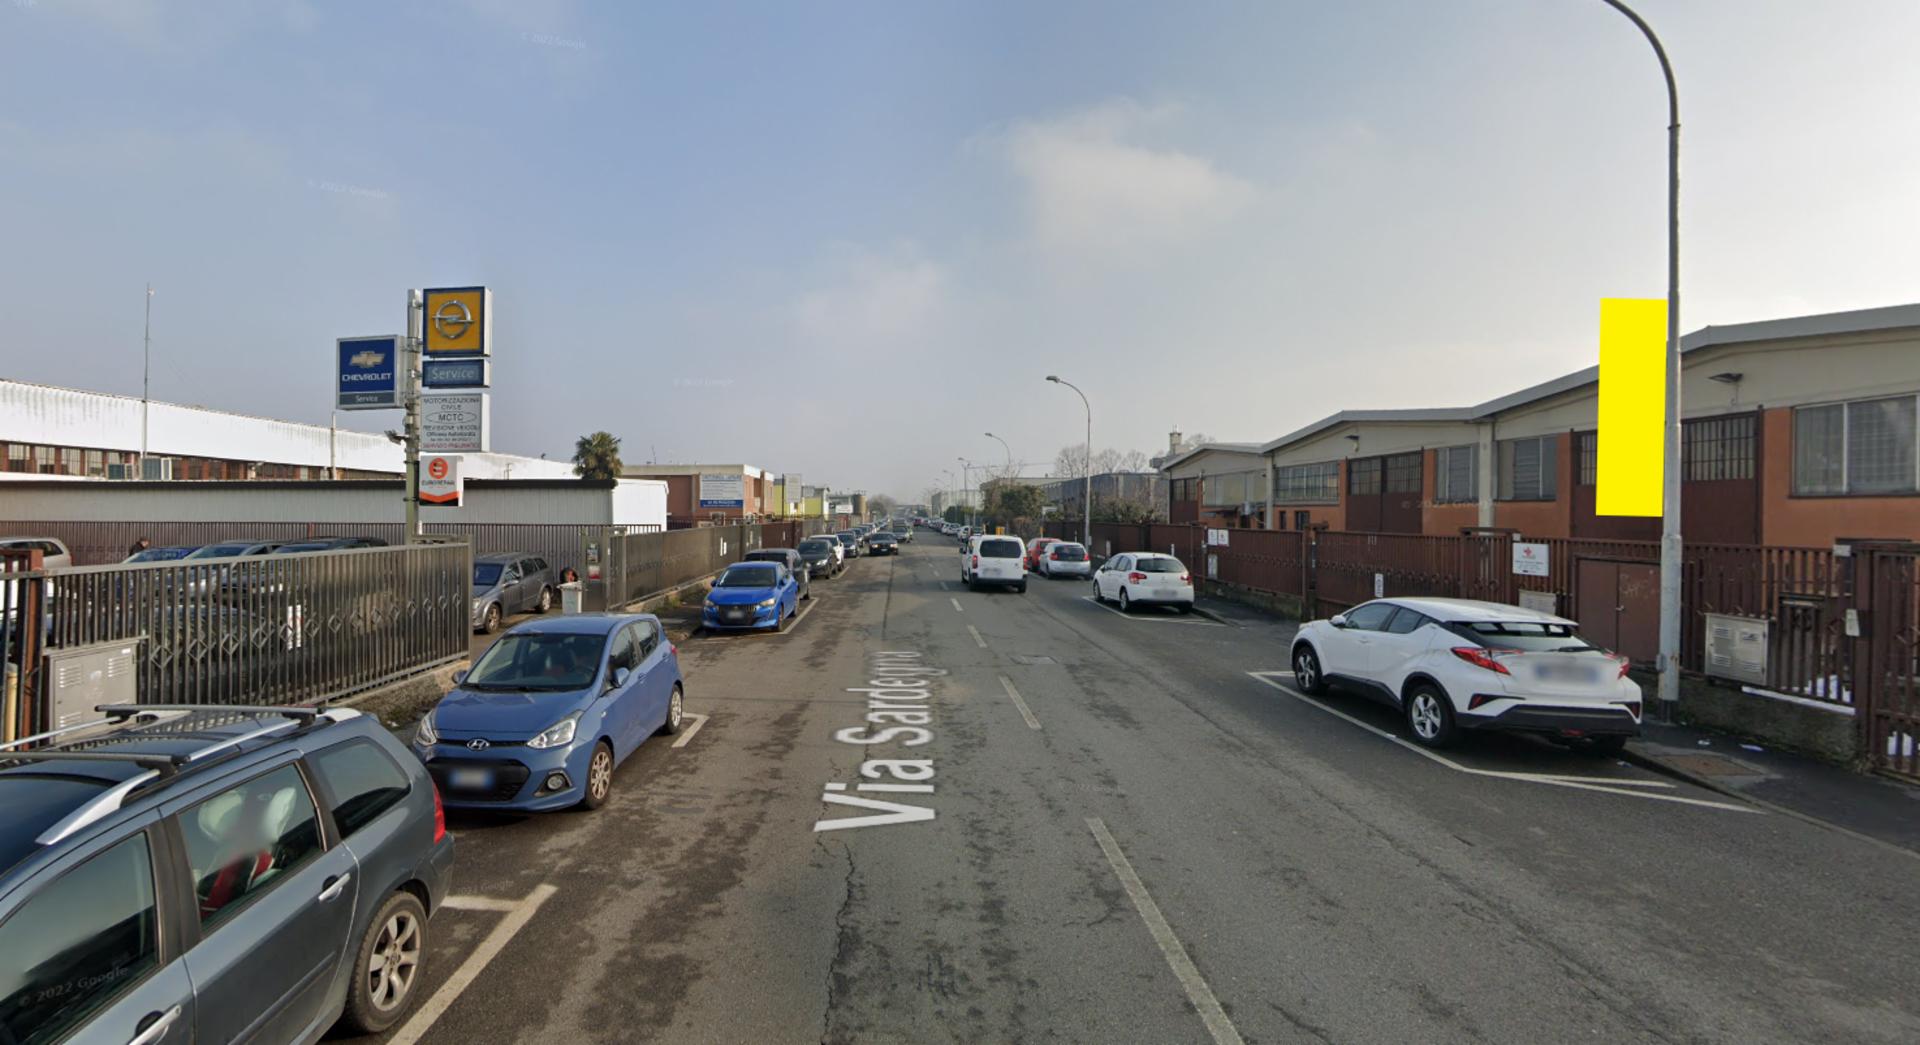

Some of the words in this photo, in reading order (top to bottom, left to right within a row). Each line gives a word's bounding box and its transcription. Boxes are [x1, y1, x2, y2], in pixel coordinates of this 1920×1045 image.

[342, 373, 392, 382] CHEVROLET
[431, 367, 475, 380] Service
[355, 395, 379, 403] Service
[438, 413, 464, 421] MCTC
